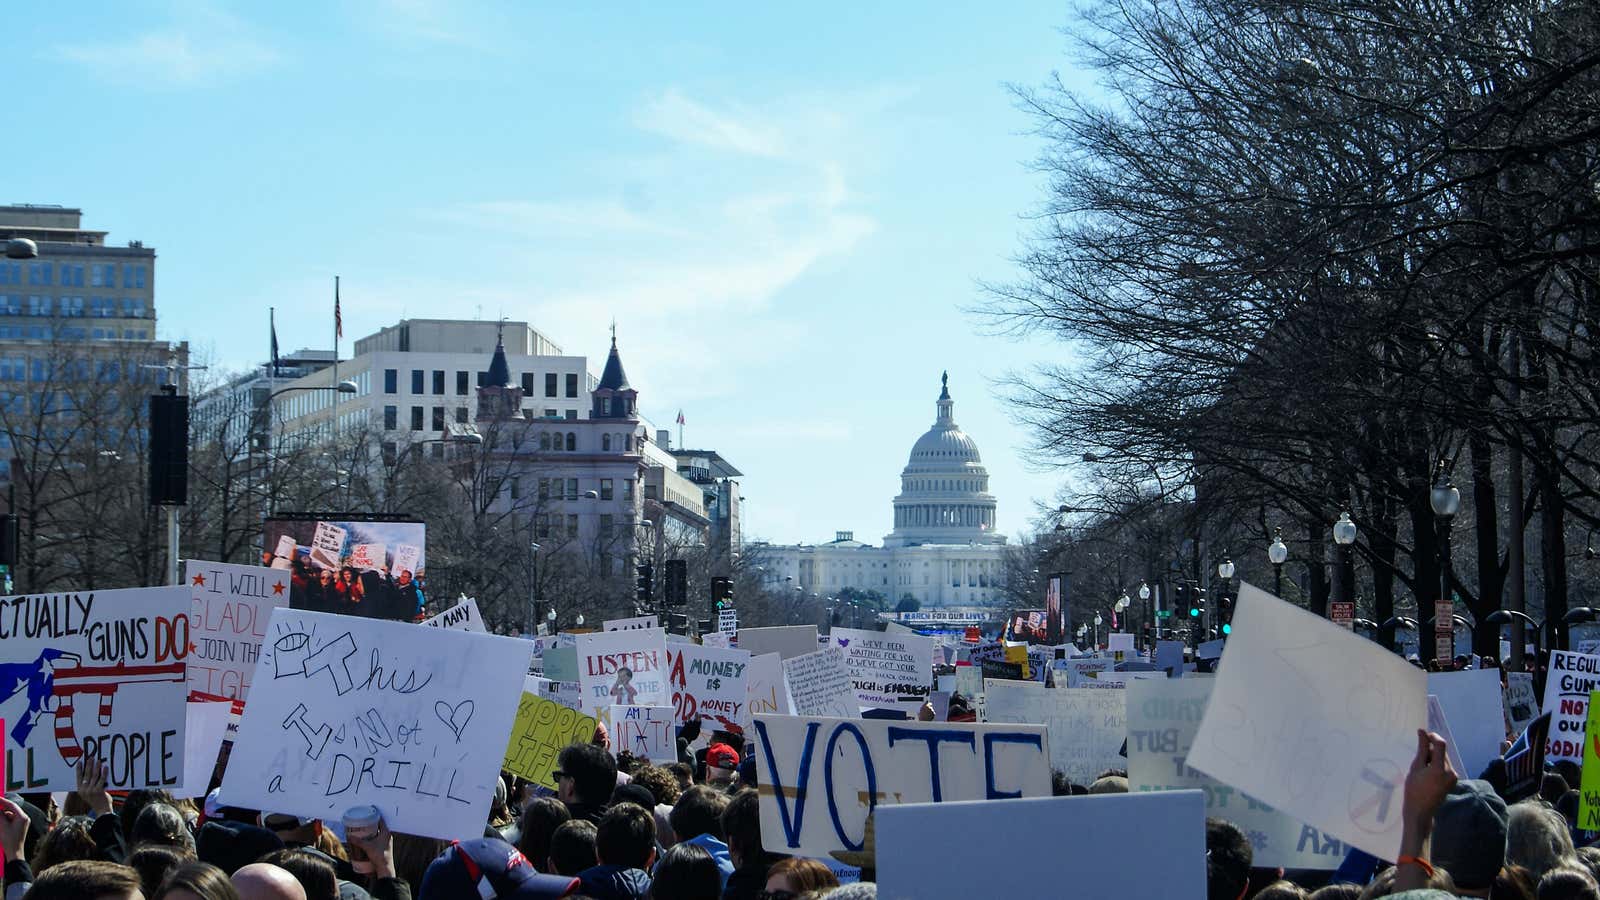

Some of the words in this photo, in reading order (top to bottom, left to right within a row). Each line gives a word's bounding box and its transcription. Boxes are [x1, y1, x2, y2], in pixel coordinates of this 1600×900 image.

[208, 571, 224, 594] I
[230, 573, 269, 598] WILL
[443, 605, 469, 629] MANY
[904, 612, 930, 620] MARCH
[932, 612, 947, 620] FOR
[948, 612, 964, 620] OUR
[966, 612, 986, 620] LIVES
[89, 618, 148, 661] GUNS
[155, 613, 189, 663] DO
[198, 638, 236, 663] JOIN
[850, 648, 881, 659] WAITING
[884, 652, 897, 660] FOR
[898, 654, 915, 662] YOU
[303, 632, 432, 696] This
[587, 651, 659, 676] LISTEN
[690, 658, 746, 678] MONEY
[879, 661, 893, 669] GOT
[896, 664, 917, 673] YOUR
[1554, 653, 1600, 674] REGUL
[593, 685, 608, 698] TO
[636, 681, 659, 694] THE
[750, 686, 778, 715] ON
[884, 683, 930, 697] ENOUGH
[625, 708, 640, 719] AM
[646, 708, 652, 720] I
[700, 700, 742, 715] MONEY
[1560, 700, 1588, 715] NO
[356, 708, 423, 754] Not
[84, 730, 177, 787] PEOPLE
[268, 776, 285, 793] a
[326, 754, 470, 804] DRILL
[754, 719, 1042, 851] VOTE
